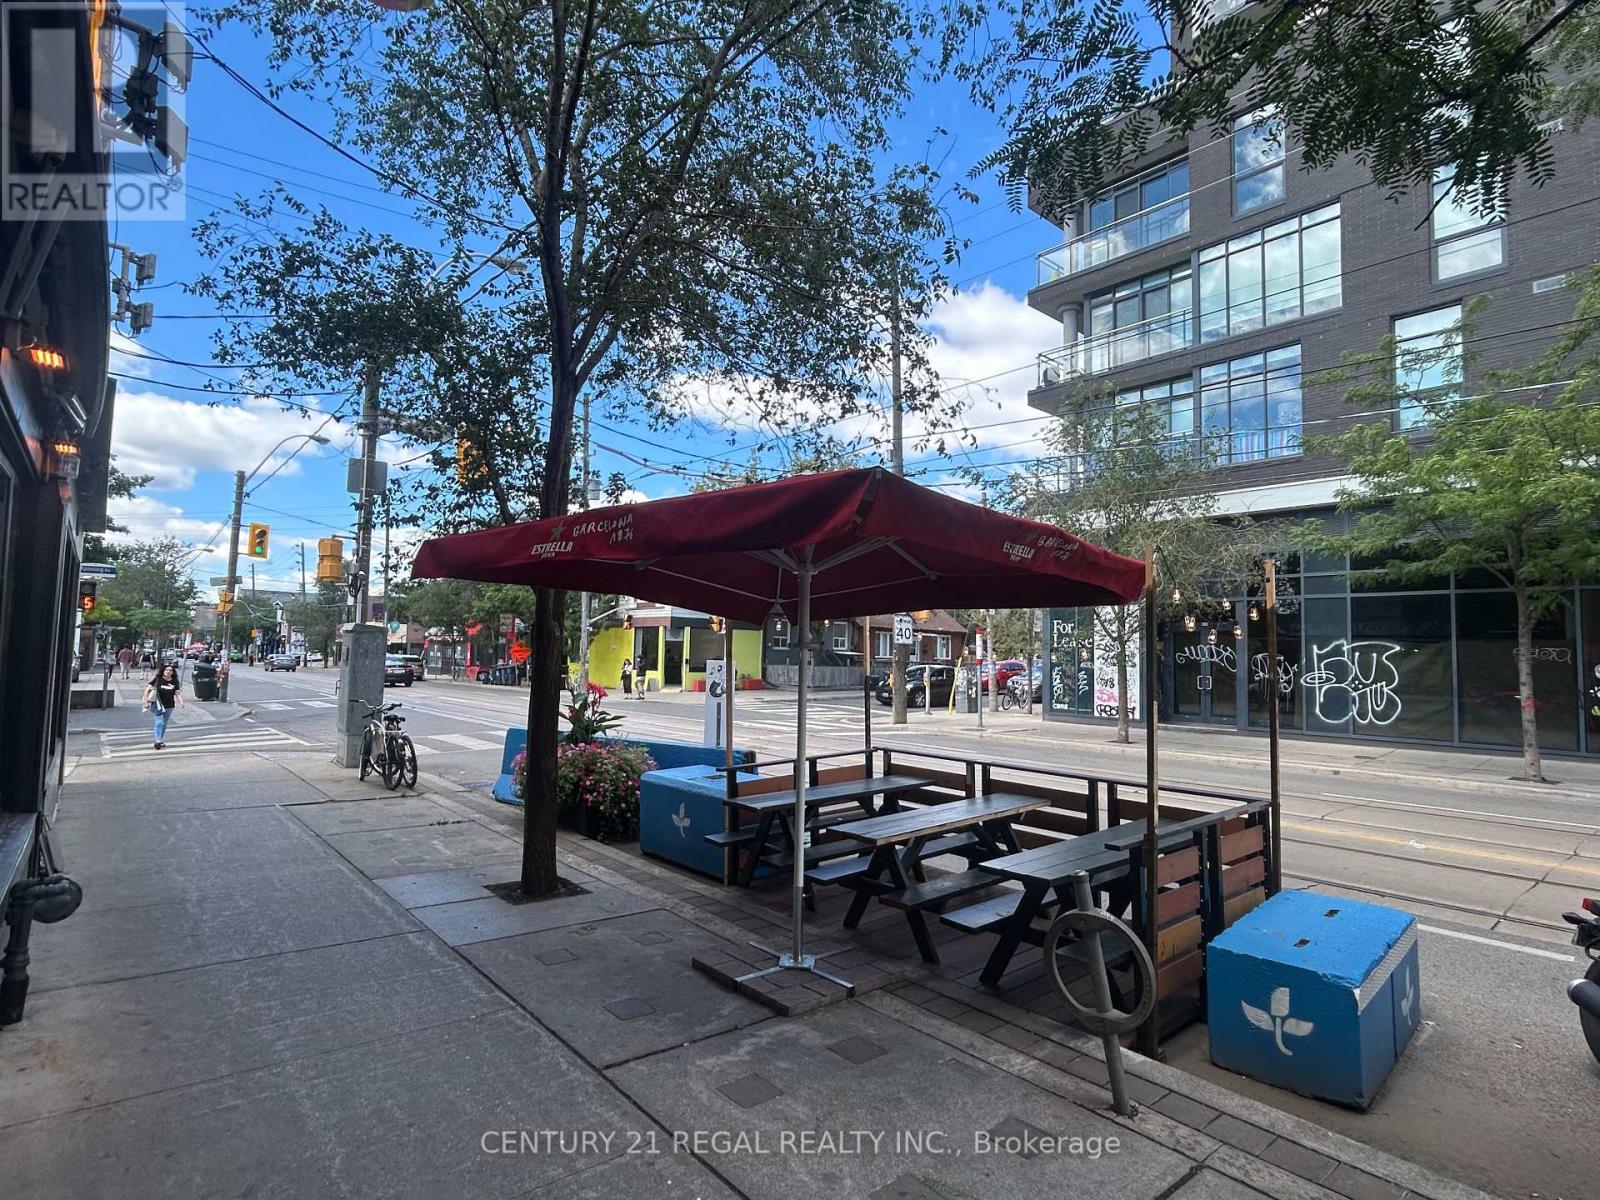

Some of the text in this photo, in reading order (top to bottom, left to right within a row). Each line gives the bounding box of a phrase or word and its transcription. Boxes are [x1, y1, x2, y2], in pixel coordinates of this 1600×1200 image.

[531, 541, 573, 555] ESTRELLA
[1003, 541, 1035, 559] ESTRELLA
[896, 627, 911, 640] 40
[1053, 620, 1074, 634] For
